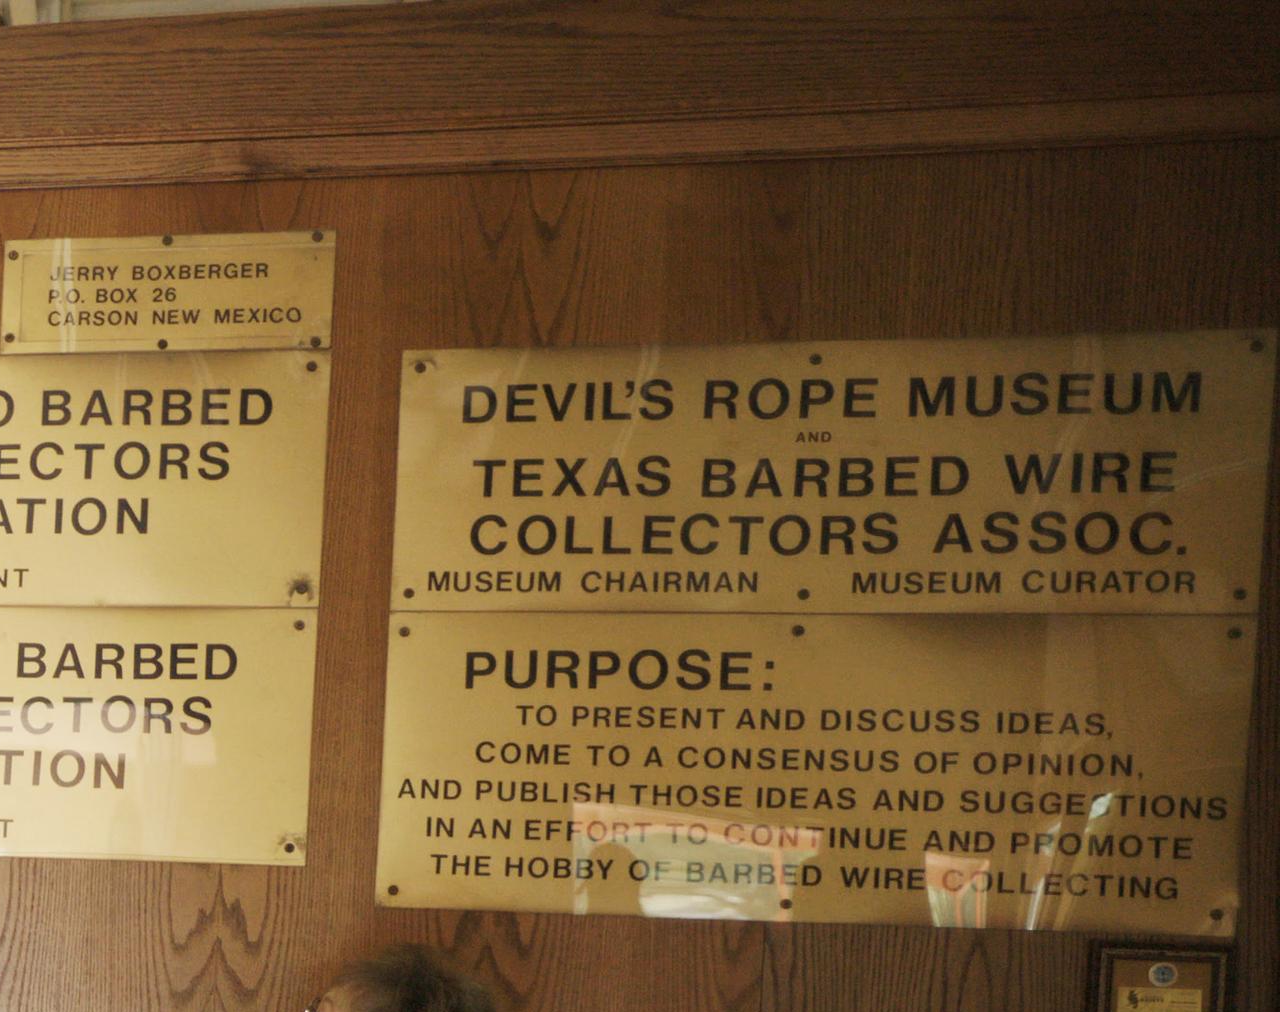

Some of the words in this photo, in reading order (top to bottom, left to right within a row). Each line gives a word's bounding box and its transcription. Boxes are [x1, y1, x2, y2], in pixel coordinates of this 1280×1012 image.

[50, 266, 118, 282] JERRY
[132, 262, 269, 281] BOXBERGER
[48, 288, 85, 304] P.O.
[96, 288, 137, 303] BOX
[152, 287, 177, 303] 26
[48, 311, 138, 326] CARSON
[152, 309, 201, 325] NEW
[214, 307, 302, 324] MEXICO
[40, 388, 274, 427] BARBED
[462, 378, 676, 424] DEVIL'S
[702, 377, 880, 421] ROPE
[908, 371, 1203, 418] MUSEUM
[795, 430, 833, 444] AND
[472, 455, 672, 499] TEXAS
[701, 453, 971, 498] BARBED
[1004, 450, 1180, 494] WIRE
[469, 511, 900, 557] COLLECTORS
[932, 511, 1189, 557] ASSOC.
[426, 570, 562, 594] MUSEUM
[579, 570, 759, 594] CHAIRMAN
[851, 570, 1002, 594] MUSEUM
[1020, 570, 1197, 595] CURATOR
[15, 641, 239, 681] BARBED
[465, 648, 777, 693] PURPOSE:
[516, 705, 557, 728] TO
[570, 705, 725, 731] PRESENT
[736, 707, 805, 731] AND
[820, 708, 981, 735] DISCUSS
[995, 711, 1114, 740] IDEAS,
[475, 741, 569, 767] COME
[586, 743, 632, 768] TO
[642, 745, 666, 769] A
[677, 745, 901, 773] CONSENSUS
[914, 749, 961, 774] OF
[972, 750, 1143, 779] OPINION,
[397, 779, 463, 801] AND
[475, 780, 617, 805] PUBLISH
[630, 783, 744, 808] THOSE
[755, 786, 858, 811] IDEAS
[873, 788, 945, 814] AND
[959, 790, 1229, 820] SUGGESTIONS
[424, 818, 456, 840] IN
[467, 818, 513, 841] AN
[524, 818, 651, 845] EFFORT
[665, 822, 709, 847] TO
[723, 823, 908, 852] CONTINUE
[923, 827, 997, 854] AND
[1010, 830, 1194, 860] PROMOTE
[430, 853, 493, 878] THE
[504, 855, 613, 881] HOBBY
[628, 858, 670, 881] OF
[686, 859, 823, 886] BARBED
[839, 863, 928, 891] WIRE
[941, 867, 1179, 901] COLLECTING
